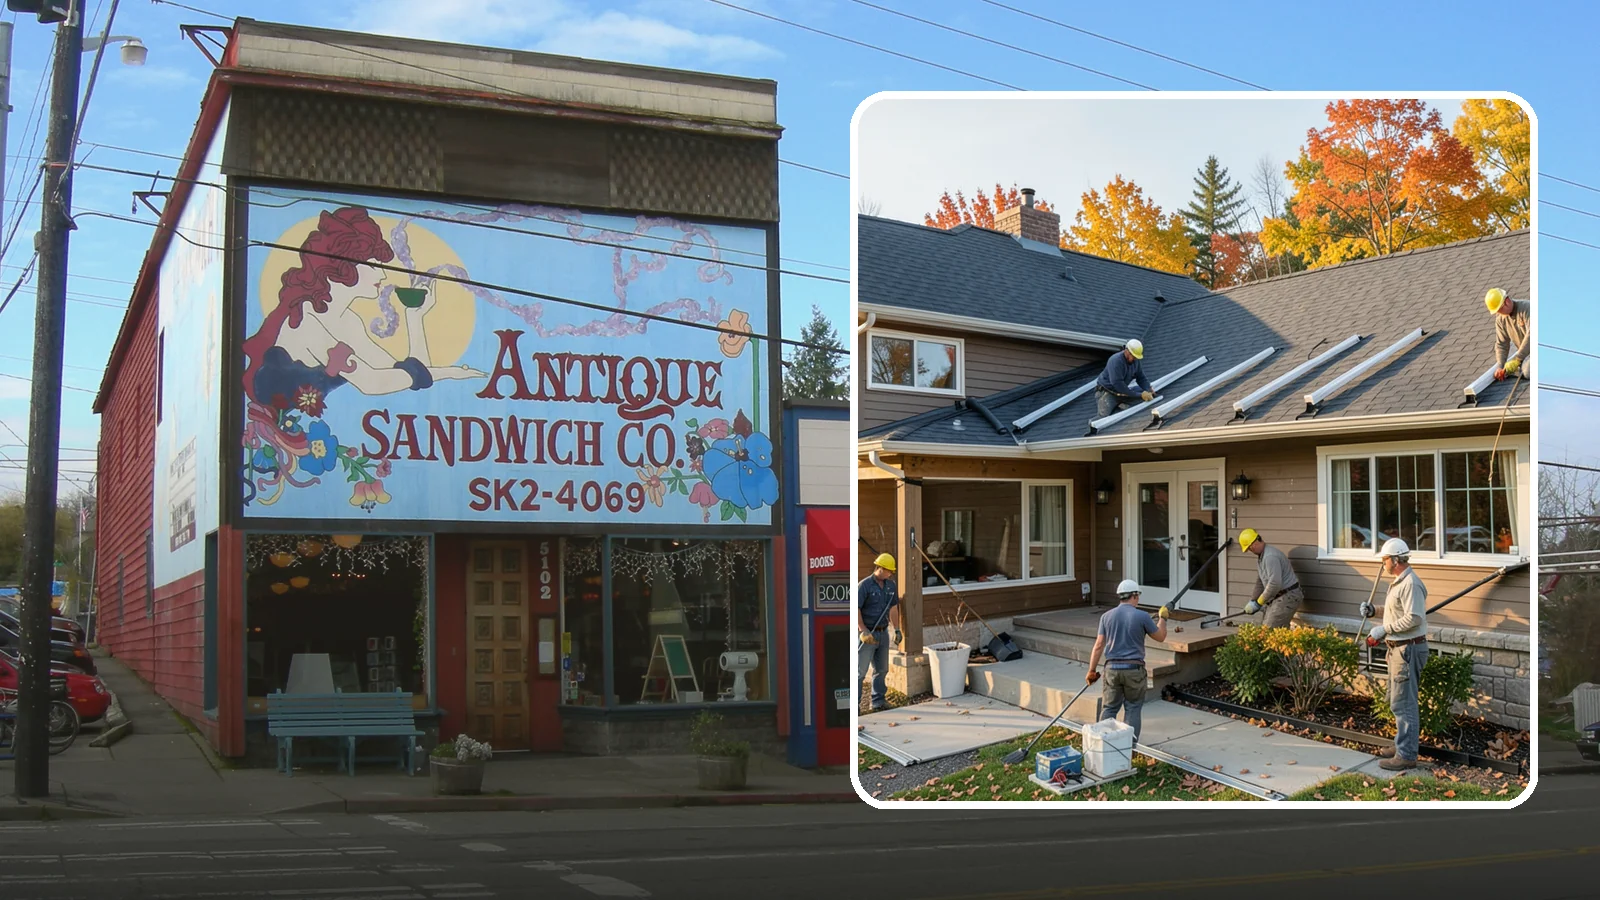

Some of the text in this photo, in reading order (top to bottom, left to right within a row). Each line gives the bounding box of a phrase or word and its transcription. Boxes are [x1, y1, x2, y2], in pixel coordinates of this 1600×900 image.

[475, 329, 723, 421] ANTIQUE
[361, 408, 684, 468] SANDWICH CO.
[469, 477, 645, 512] SK2-4069
[540, 542, 551, 599] 5102
[809, 555, 834, 568] BOOKS
